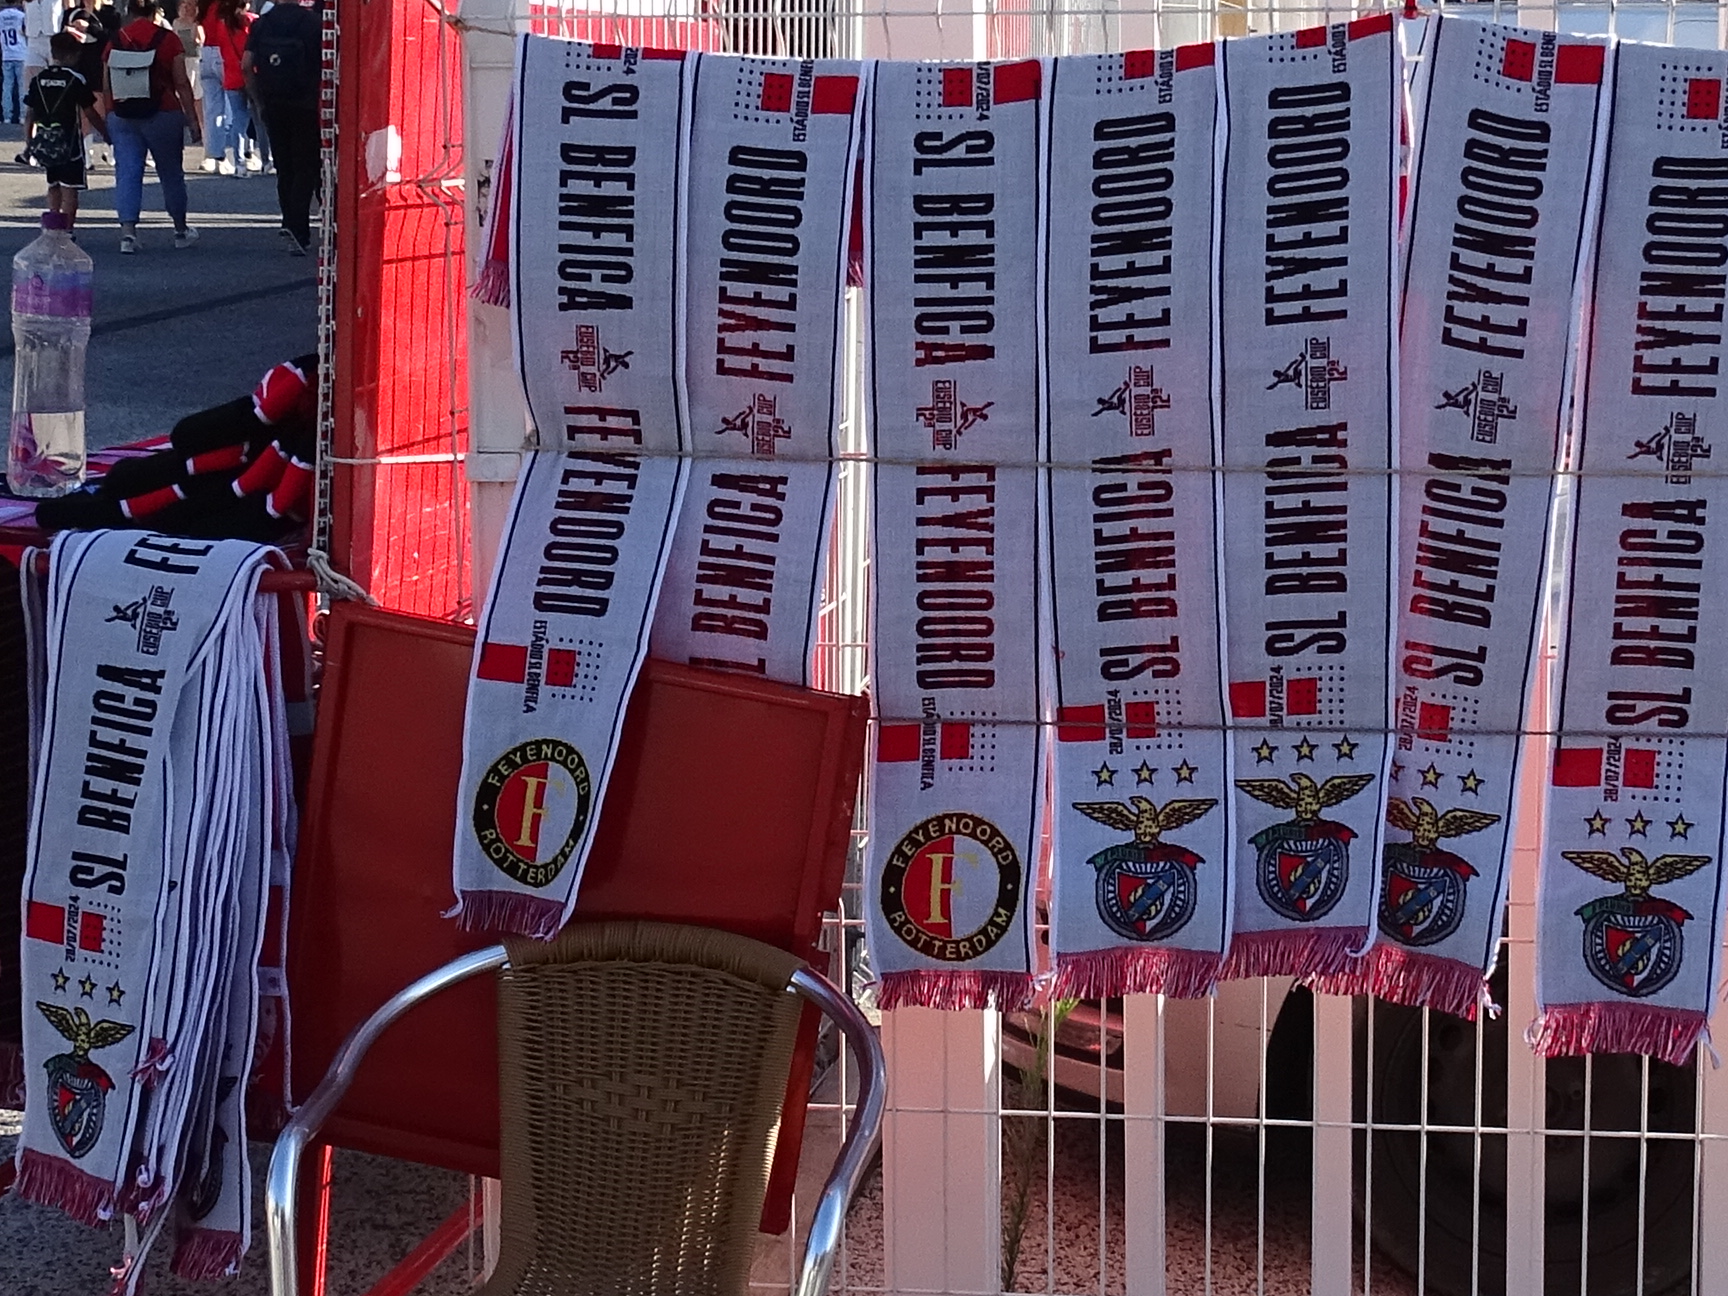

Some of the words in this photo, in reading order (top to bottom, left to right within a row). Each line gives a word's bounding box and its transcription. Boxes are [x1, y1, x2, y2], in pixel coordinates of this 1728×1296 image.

[2, 29, 17, 46] 19
[560, 80, 642, 126] SL
[976, 61, 991, 122] /07/2024
[558, 142, 638, 312] BENFICA
[913, 130, 996, 176] SL
[1089, 111, 1177, 355] FEYENOORD
[1264, 80, 1352, 326] FEYENOORD
[1441, 107, 1552, 359] FEYENOORD
[715, 144, 808, 384] FEYENOORD
[913, 192, 996, 368] BENFICA
[532, 406, 643, 619] FEYENOORD
[689, 471, 789, 642] BENFICA
[914, 463, 996, 691] FEYENOORD
[1091, 448, 1180, 623] BENFICA
[1264, 420, 1349, 597] BENFICA
[1409, 450, 1512, 631] BENFICA
[1610, 498, 1708, 671] BENFICA
[1099, 635, 1181, 681] SL
[1265, 609, 1348, 658] SL
[1401, 641, 1488, 688] SL
[1605, 686, 1692, 728] SL
[76, 664, 167, 835] BENFICA
[487, 741, 589, 798] FEYENOORD
[69, 851, 128, 897] SL
[480, 828, 576, 886] ROTTERDAM
[893, 819, 1014, 869] FEYENOORD
[887, 907, 1011, 960] ROTTERDAM
